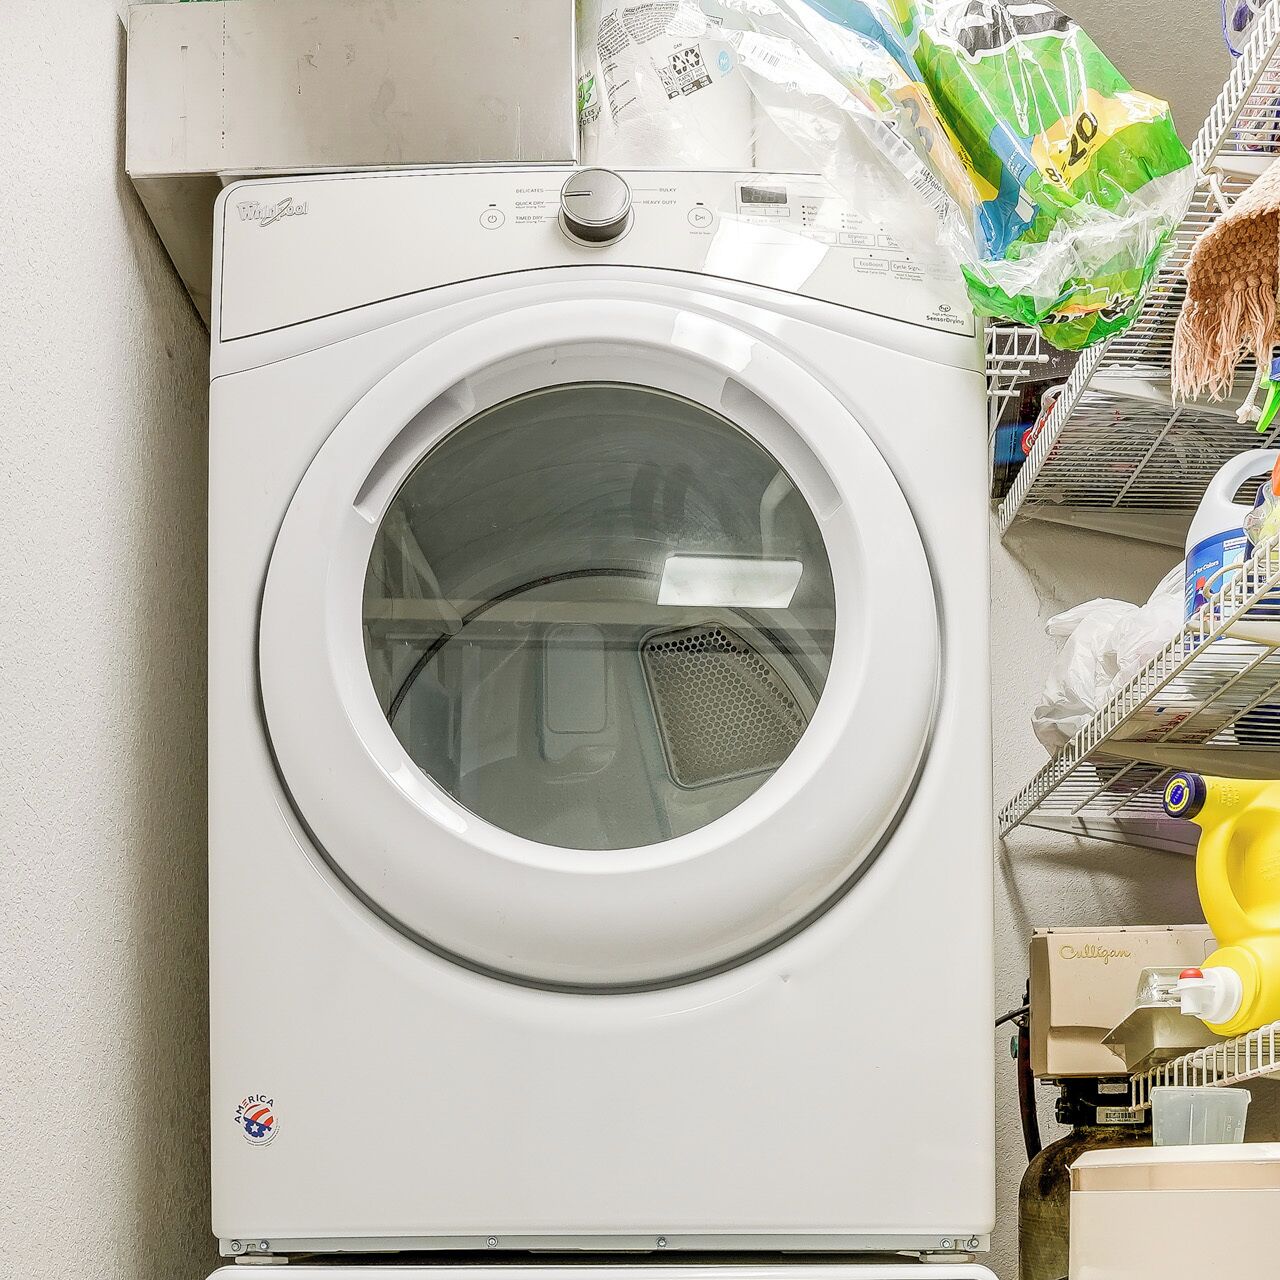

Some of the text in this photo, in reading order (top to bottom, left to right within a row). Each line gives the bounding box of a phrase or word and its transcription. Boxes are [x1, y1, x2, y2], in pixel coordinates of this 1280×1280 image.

[1068, 112, 1098, 166] 20
[235, 197, 309, 228] Whirlpool
[1059, 944, 1131, 965] Culligan
[234, 1094, 274, 1124] AMERICA
